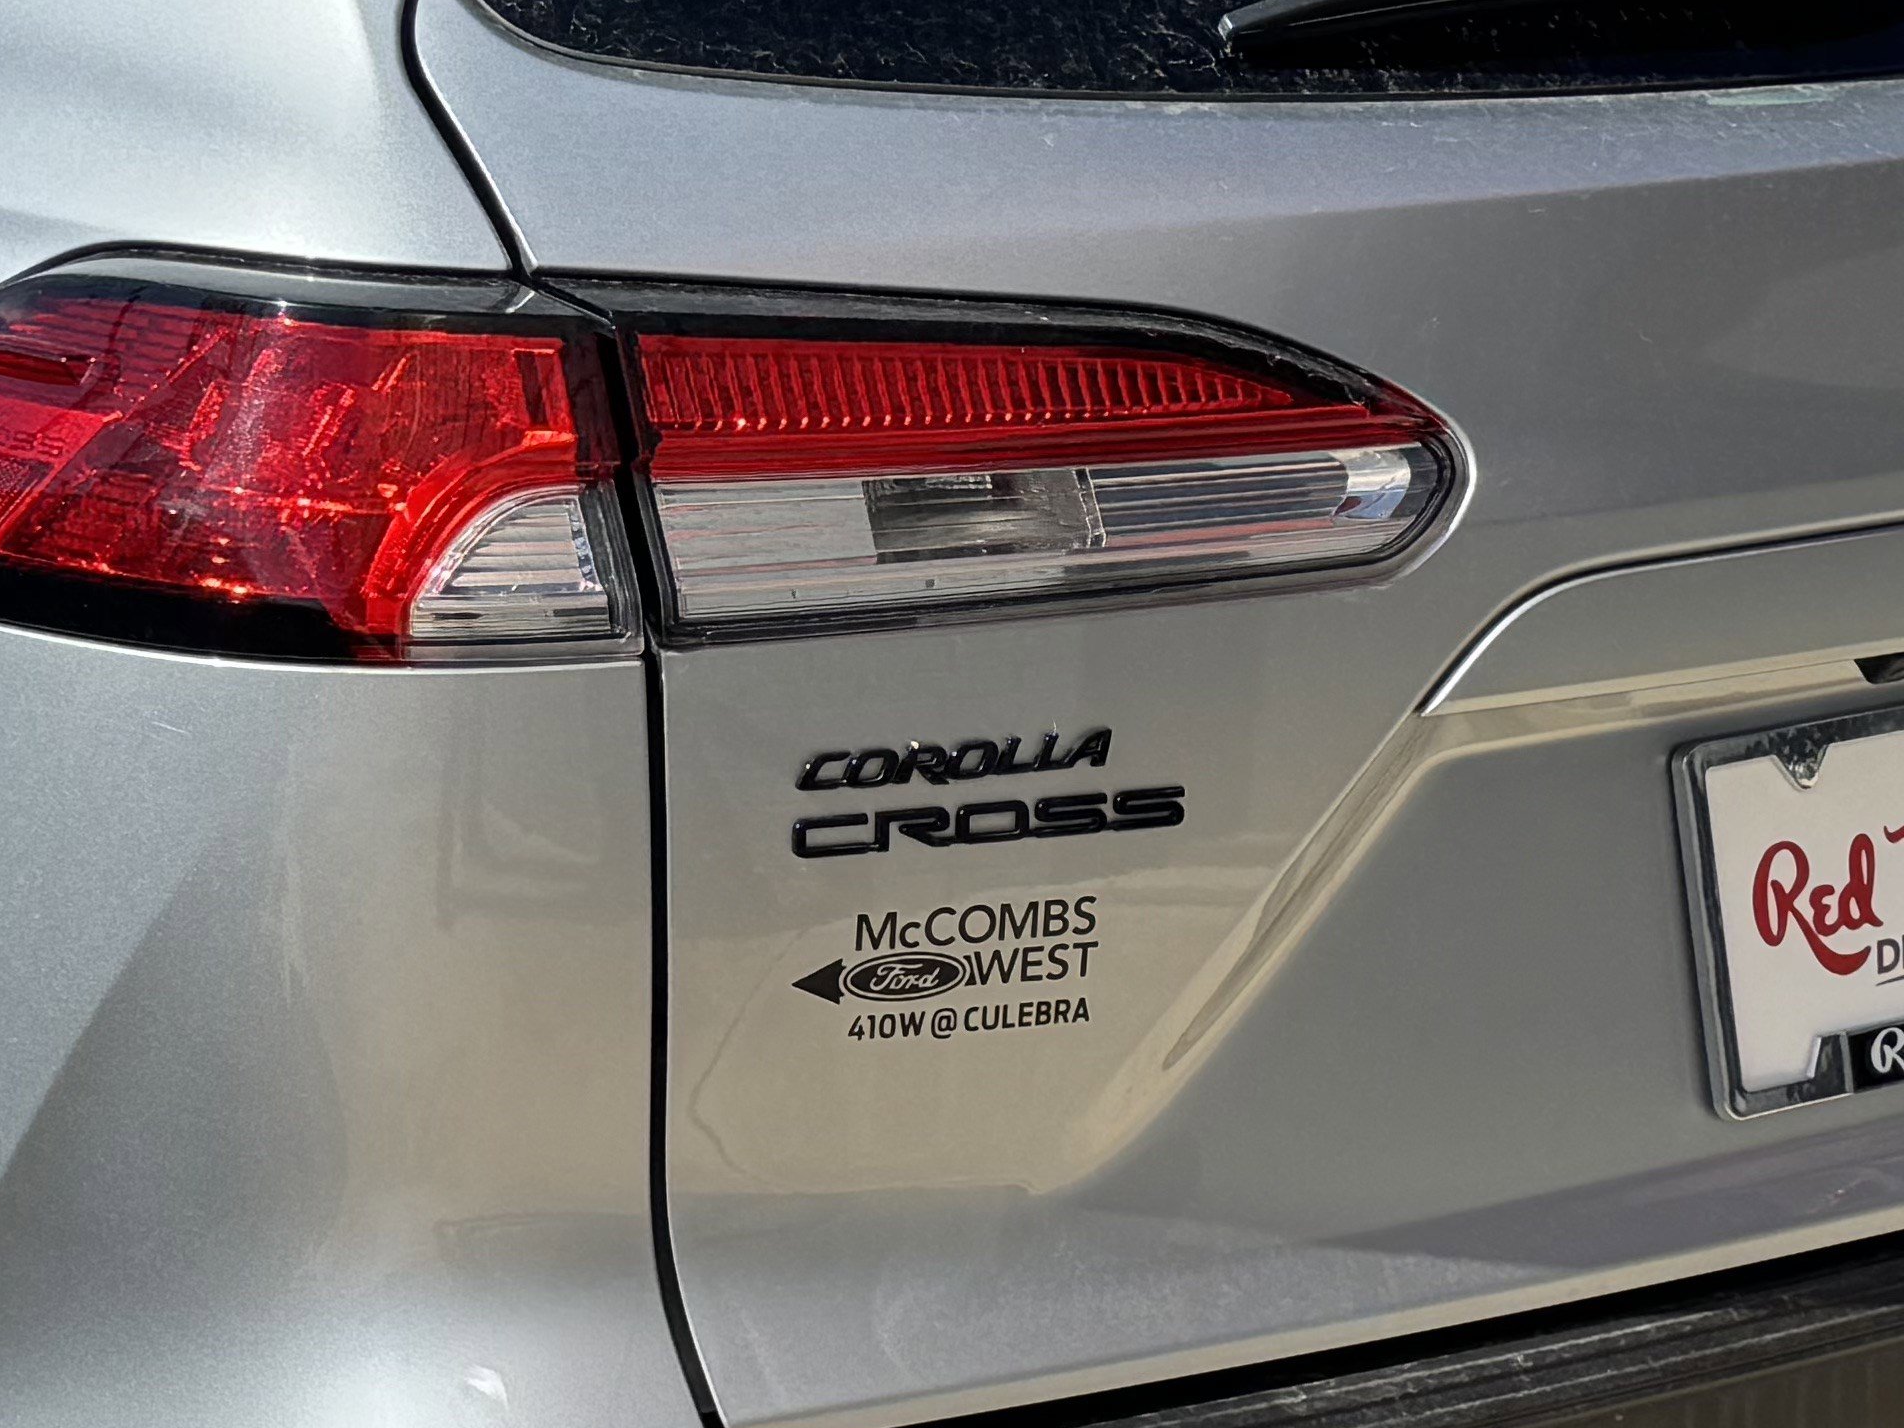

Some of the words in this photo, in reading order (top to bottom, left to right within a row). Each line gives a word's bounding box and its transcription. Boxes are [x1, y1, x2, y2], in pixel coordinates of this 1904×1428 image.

[795, 726, 1113, 791] COROLLA
[792, 785, 1186, 859] CROSS
[854, 895, 1098, 952] McCOMBS
[1752, 840, 1884, 976] Red
[868, 962, 942, 993] Ford
[970, 940, 1100, 986] WEST
[963, 997, 1091, 1033] CULEBRA
